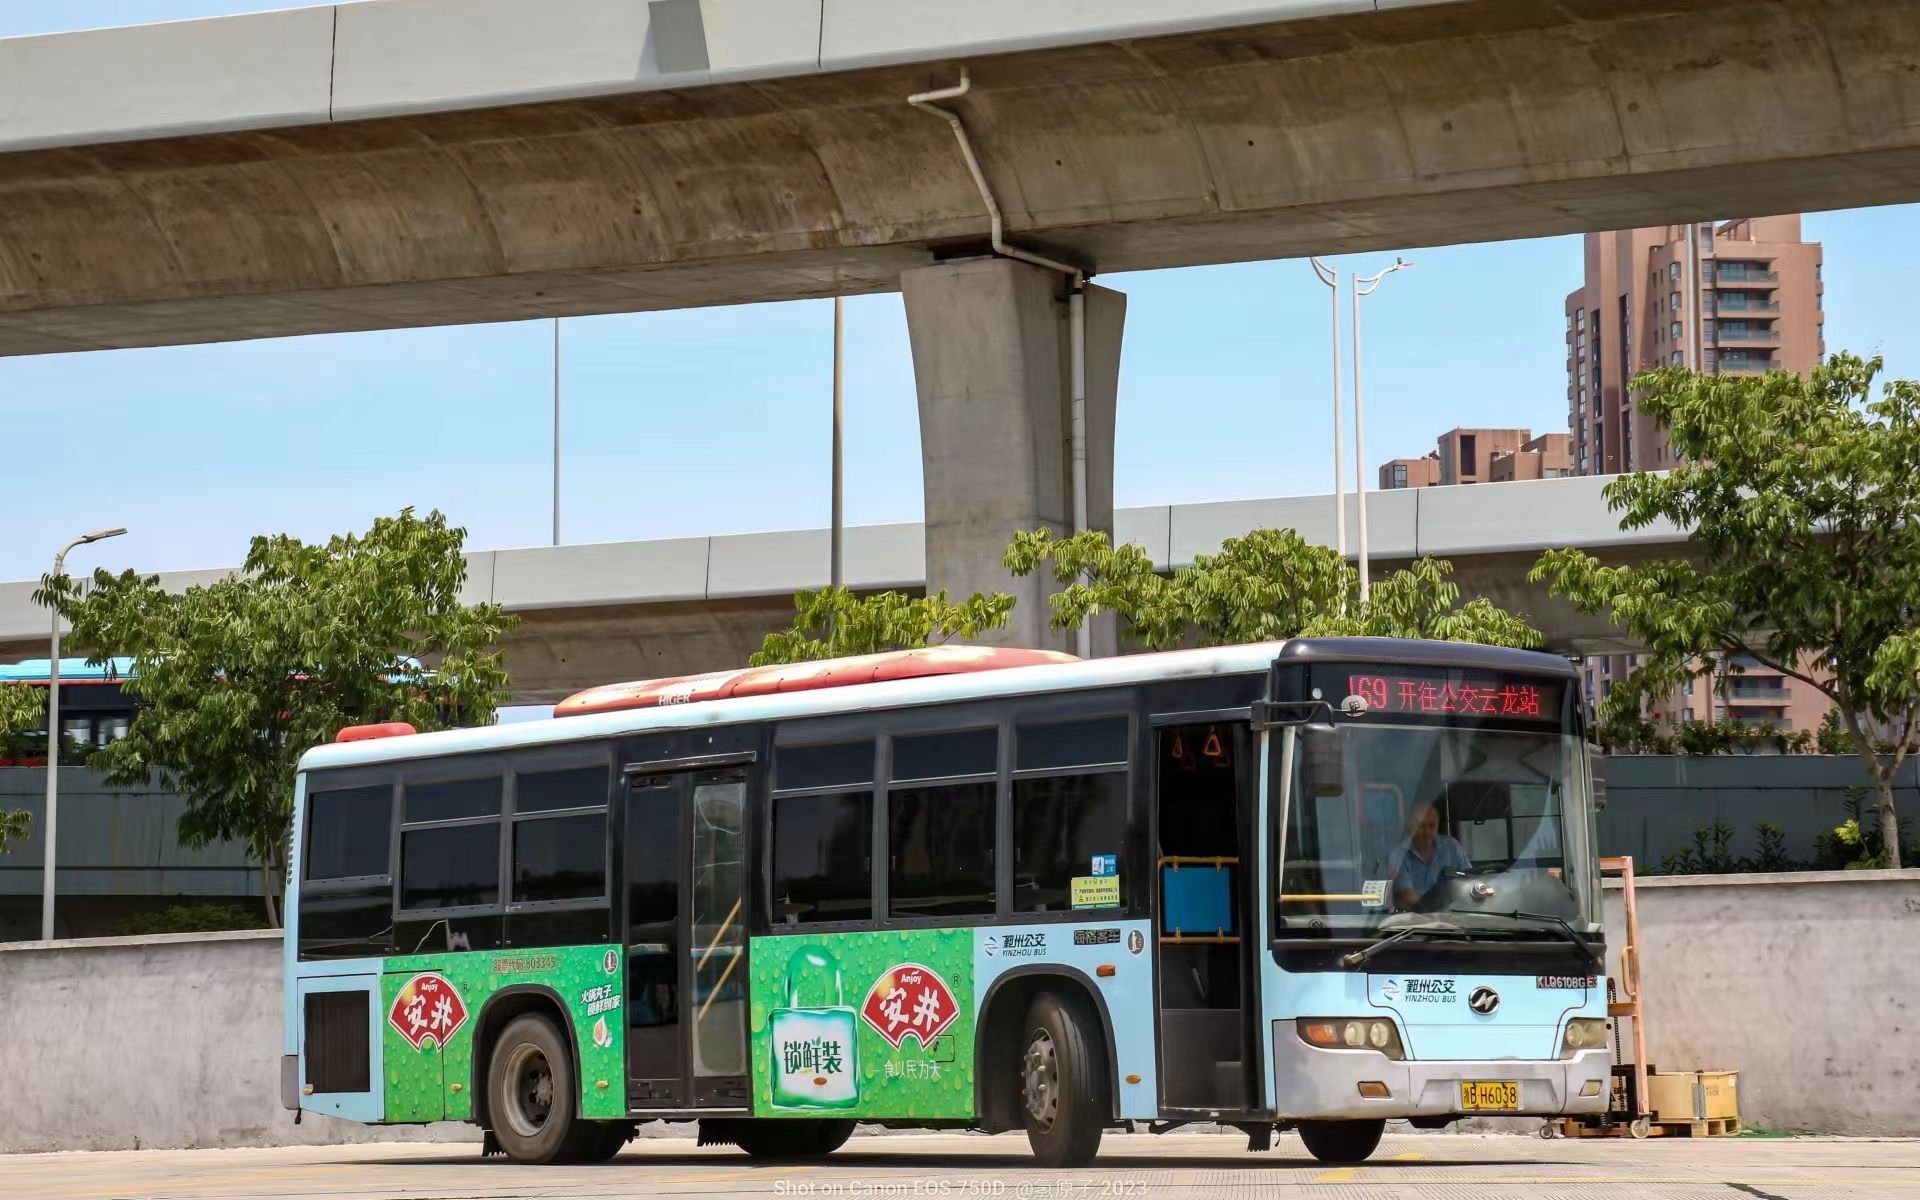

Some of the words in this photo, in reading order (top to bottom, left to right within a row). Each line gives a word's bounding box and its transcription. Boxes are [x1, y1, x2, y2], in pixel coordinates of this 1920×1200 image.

[1003, 949, 1031, 957] YINZHOU
[1033, 948, 1047, 956] BUS
[901, 970, 922, 984] Anjoy
[1404, 979, 1456, 993] 鄞州公交
[1405, 994, 1440, 1002] YINZHOU
[403, 994, 453, 1035] 安井
[880, 986, 940, 1032] 安井
[784, 1039, 842, 1074] 锁鲜装
